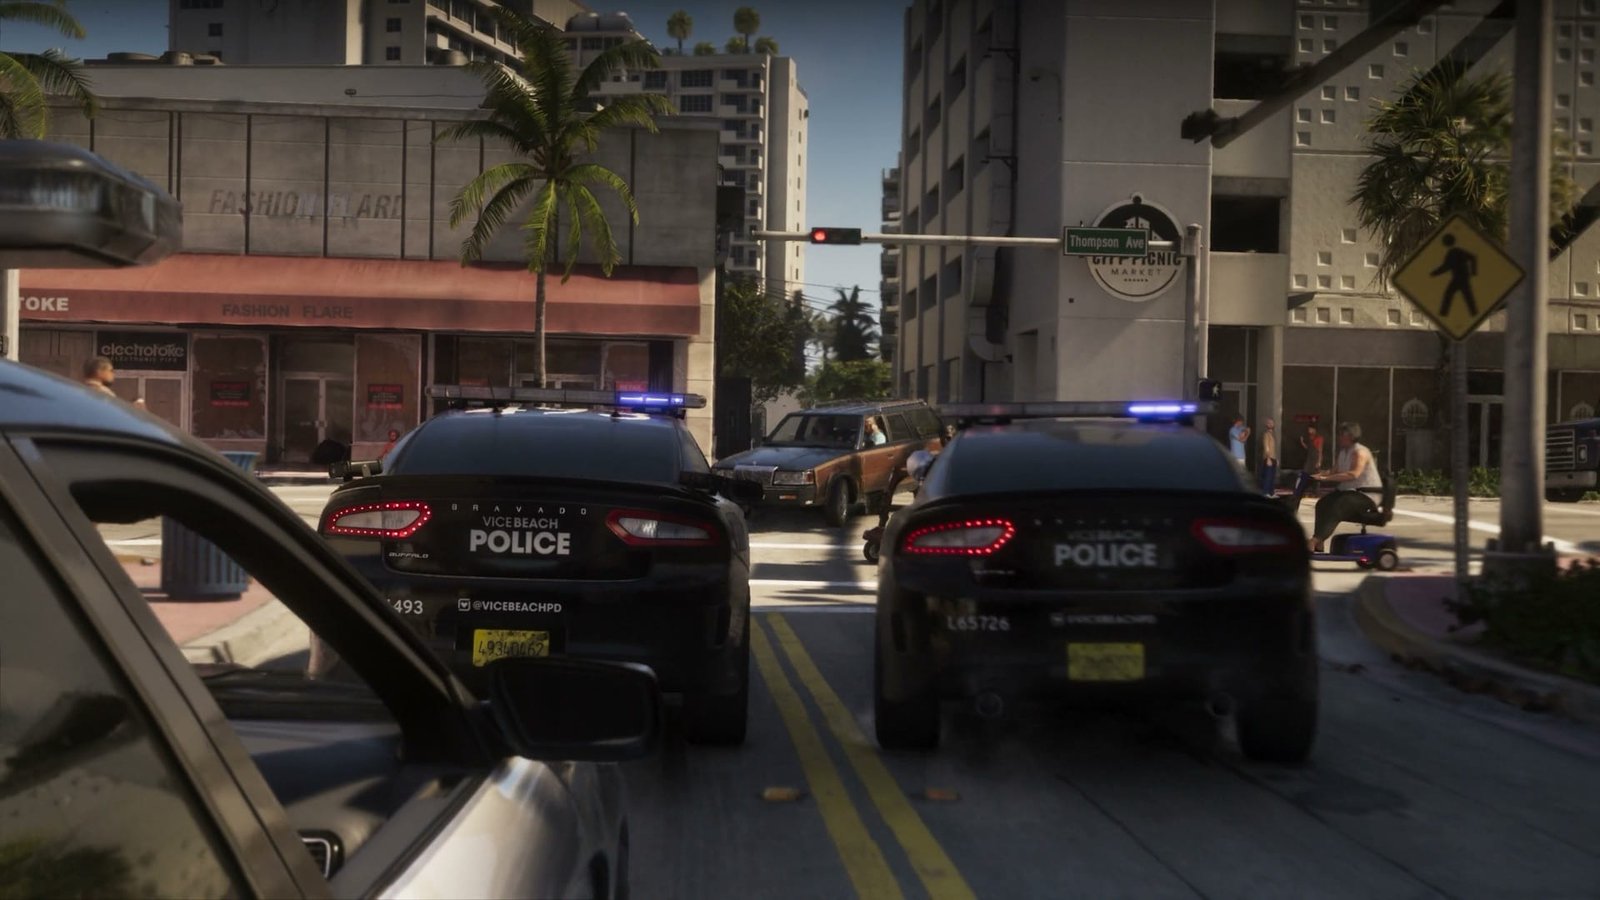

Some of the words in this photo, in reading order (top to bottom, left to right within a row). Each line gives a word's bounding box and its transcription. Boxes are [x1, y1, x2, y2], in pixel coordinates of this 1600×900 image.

[208, 188, 320, 217] FASHION
[1069, 234, 1119, 250] Thompson
[1125, 236, 1144, 249] Ave
[1111, 268, 1162, 276] MARKET
[222, 303, 290, 318] FASHION
[302, 305, 353, 319] FLARE
[451, 503, 587, 515] BRAVADO
[470, 529, 571, 555] POLICE
[1054, 544, 1158, 567] POLICE
[472, 600, 562, 613] @VICEBEACHPD
[947, 615, 1011, 631] L65726
